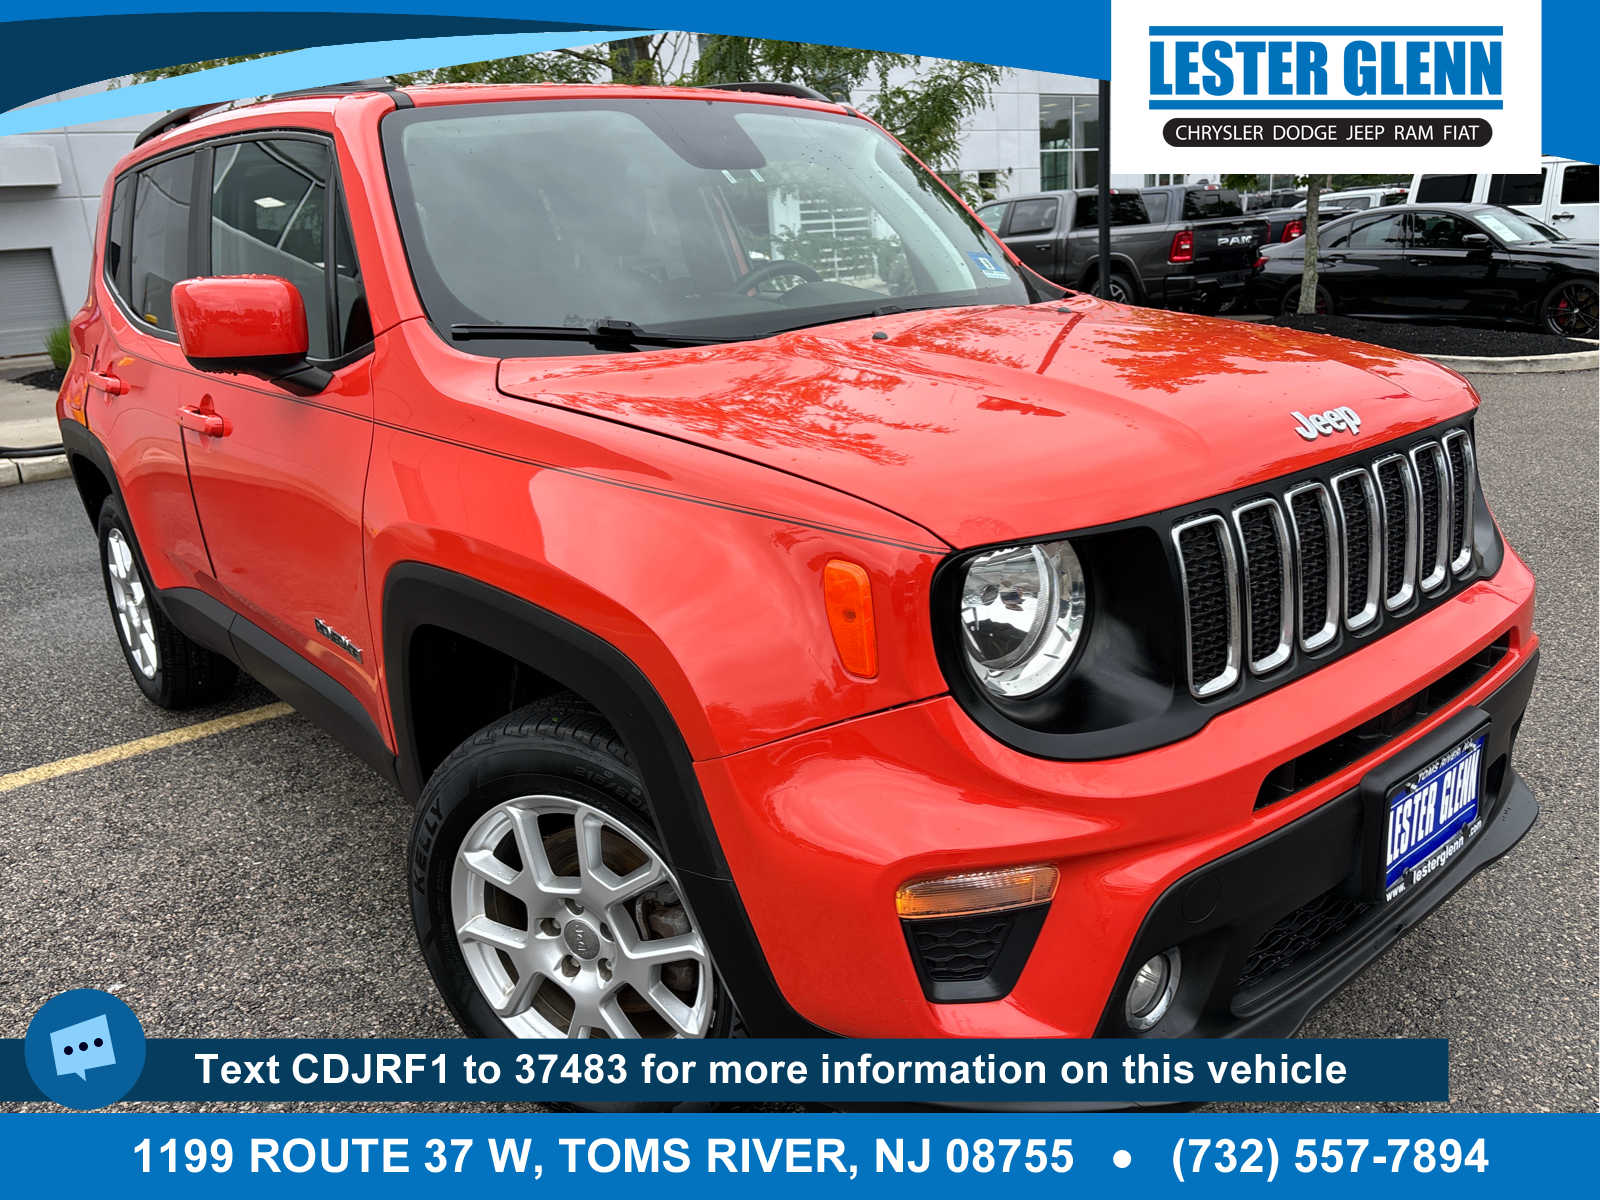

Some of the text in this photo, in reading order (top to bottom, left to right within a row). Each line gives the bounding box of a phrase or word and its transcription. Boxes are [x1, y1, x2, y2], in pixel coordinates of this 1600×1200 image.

[1290, 406, 1362, 442] Jeep
[1418, 761, 1441, 784] TOMS
[1386, 748, 1481, 868] LESTER GLENN
[414, 798, 443, 896] KELLY
[1412, 836, 1465, 886] lesterglenn
